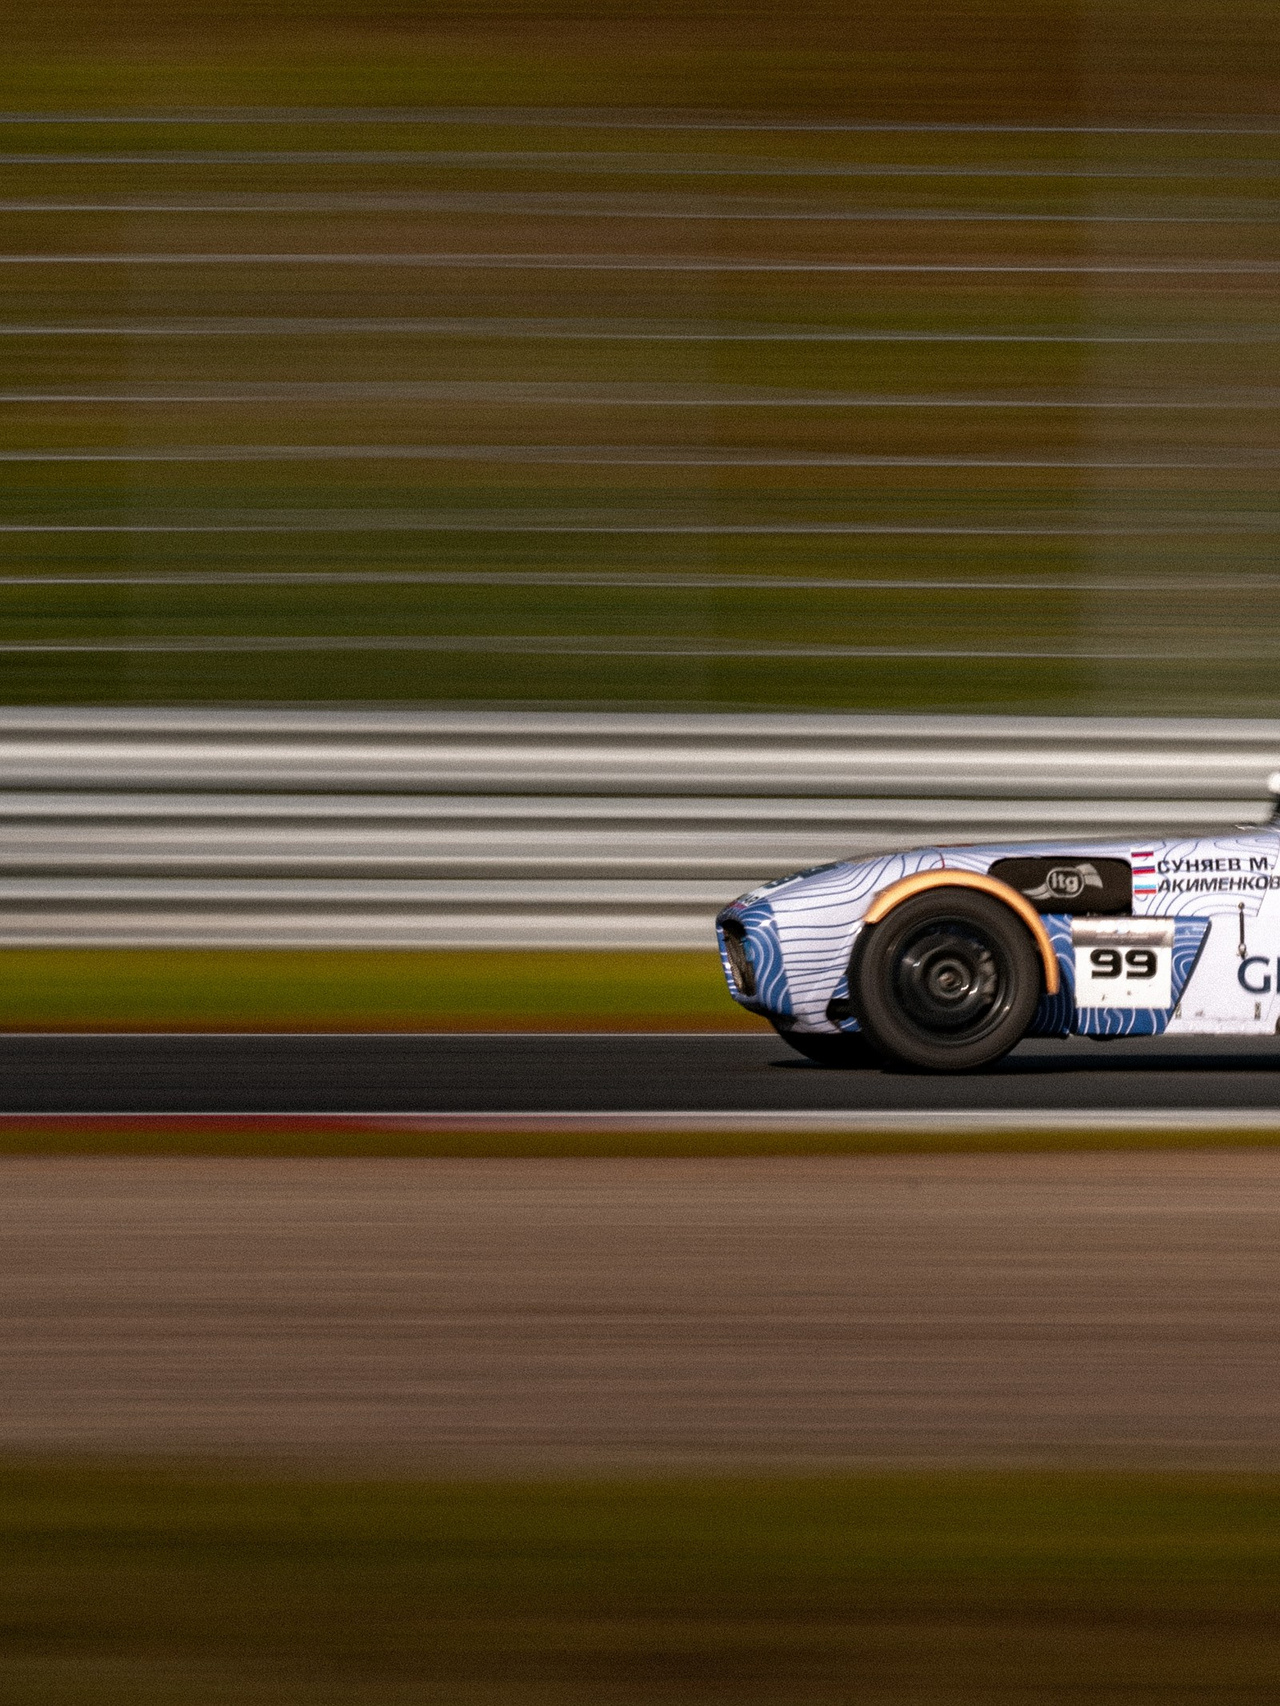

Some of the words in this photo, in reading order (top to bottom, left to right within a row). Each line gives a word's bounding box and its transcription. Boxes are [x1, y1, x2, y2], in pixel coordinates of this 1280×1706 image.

[1157, 859, 1240, 874] СУНЯЕВ
[1158, 876, 1280, 893] АКИМЕНКОВ
[1090, 949, 1158, 979] 99
